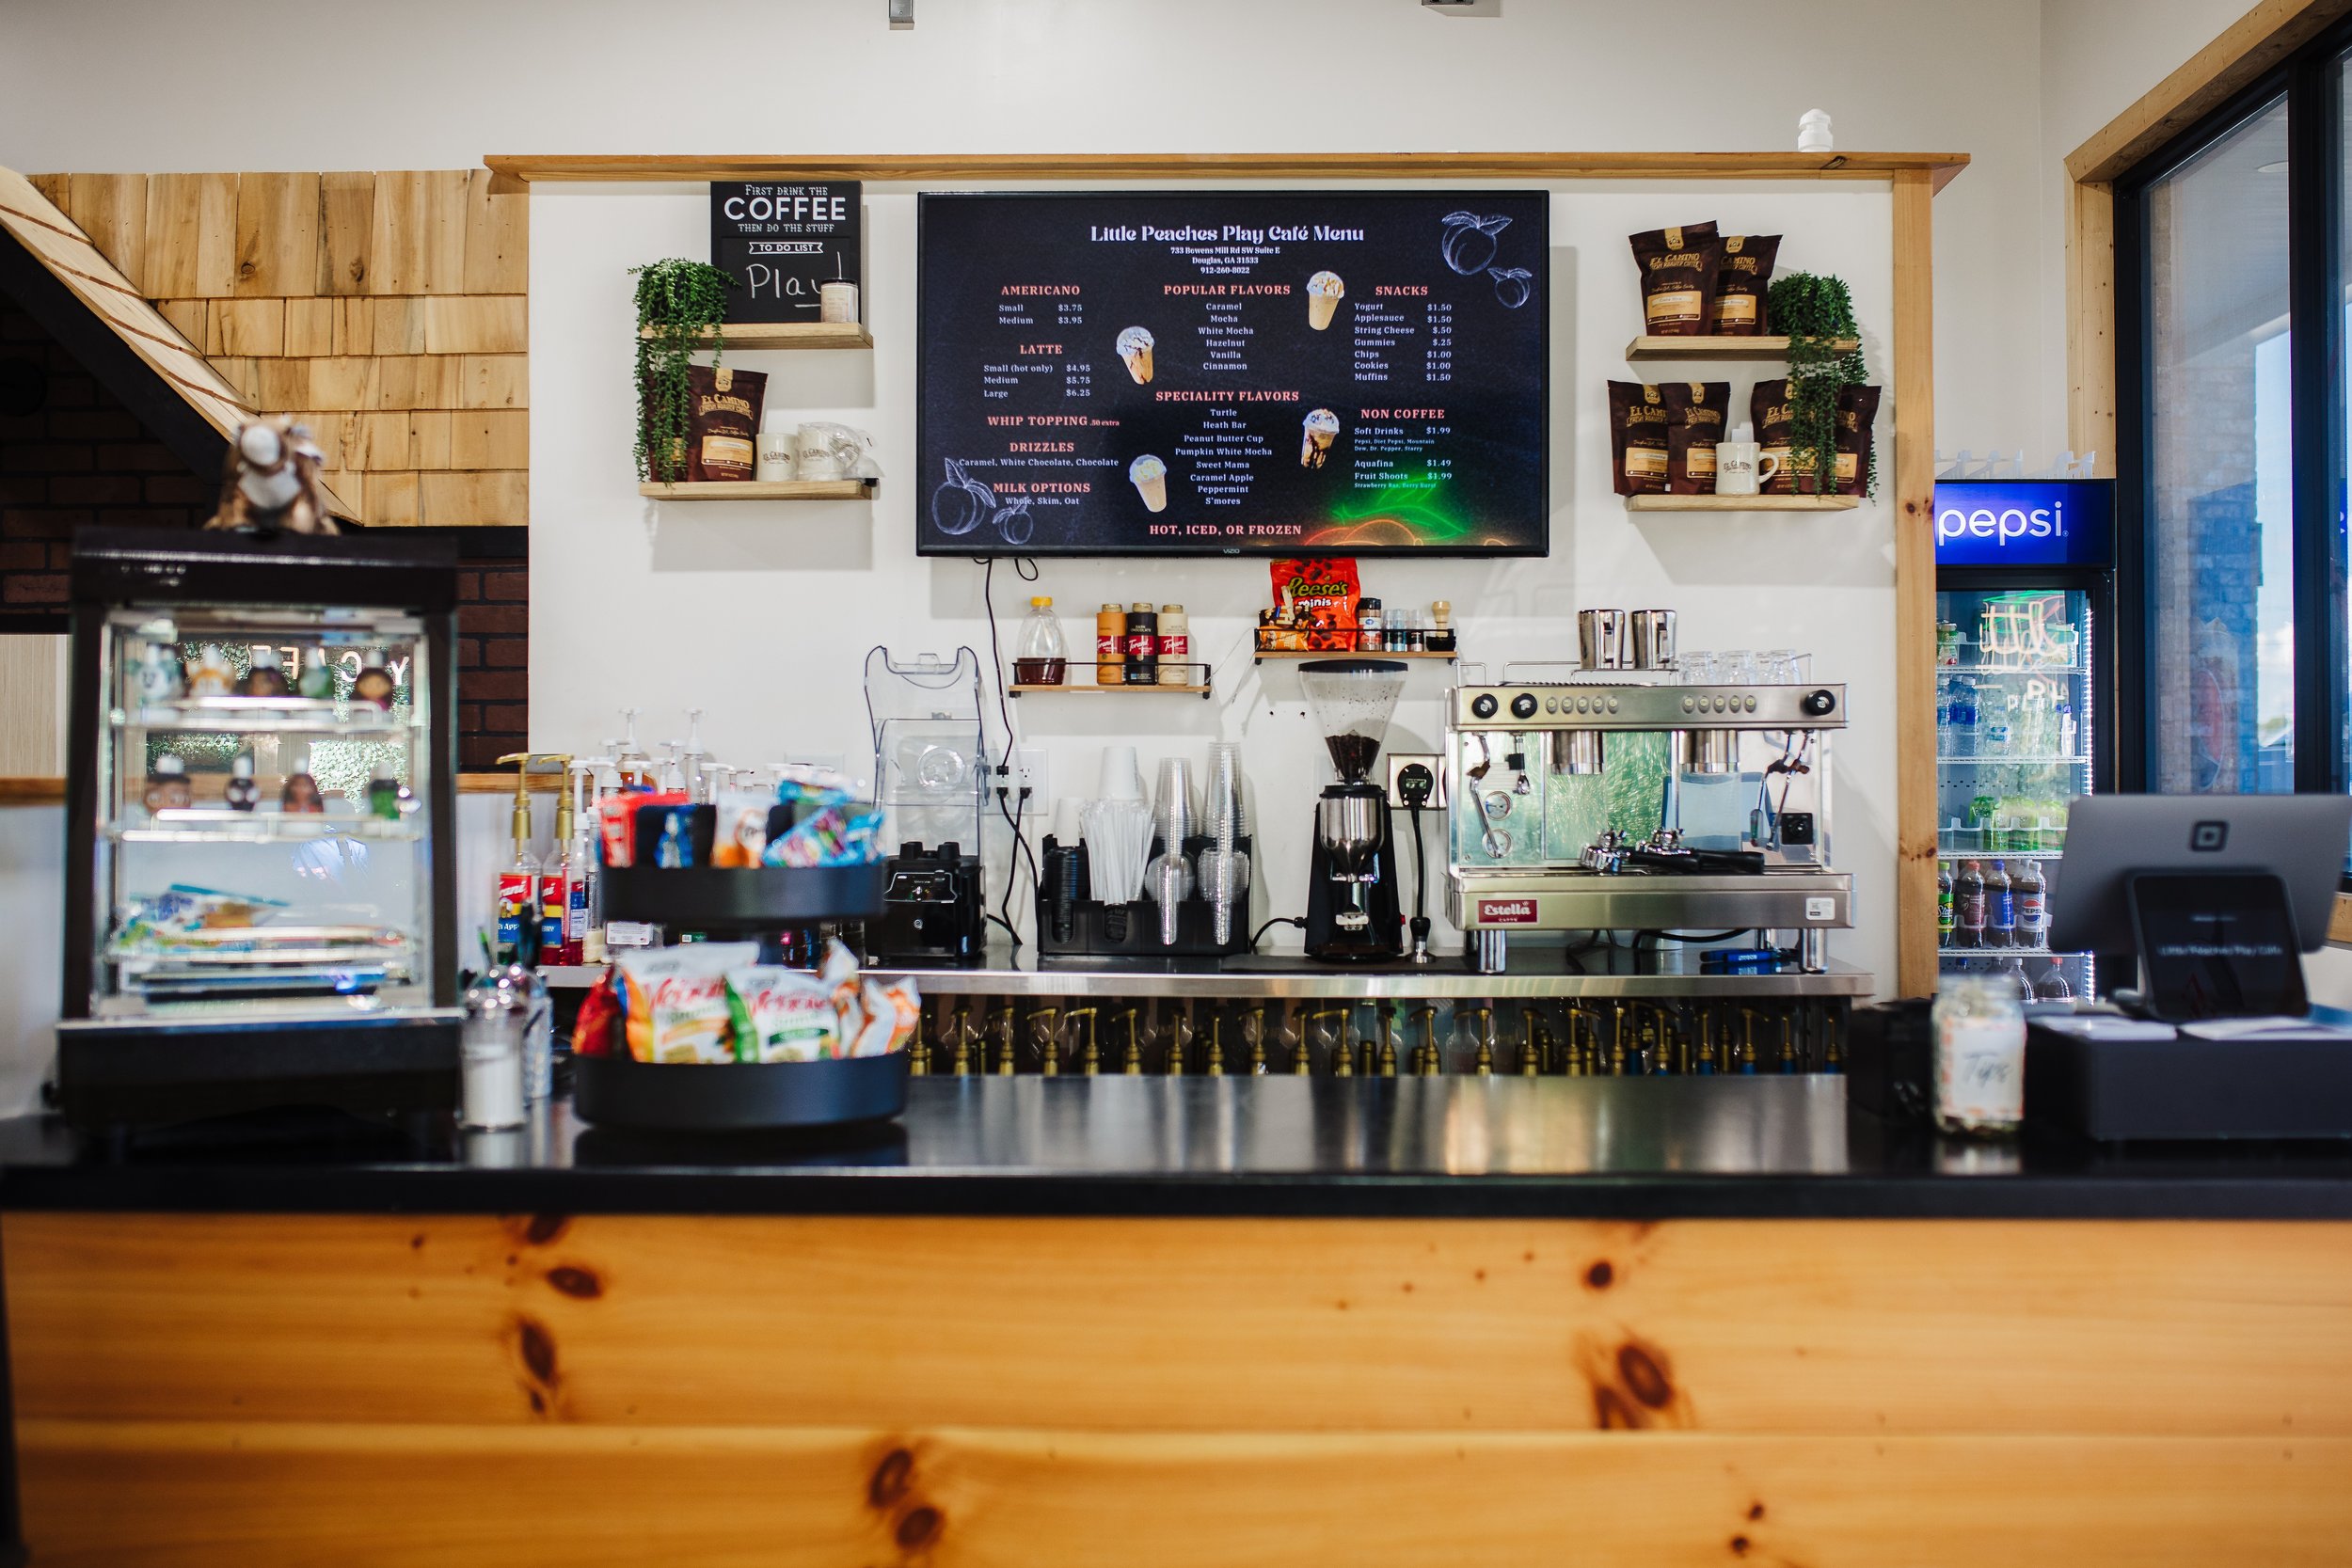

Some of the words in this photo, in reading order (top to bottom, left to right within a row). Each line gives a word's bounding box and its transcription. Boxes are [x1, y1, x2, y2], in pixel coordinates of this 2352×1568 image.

[724, 198, 846, 220] COFFEE
[784, 224, 802, 232] THE
[806, 224, 834, 232] STUFF
[1091, 226, 1136, 241] Little
[1142, 226, 1217, 241] Peaches
[1223, 226, 1263, 245] Play
[1269, 226, 1308, 241] Café
[1314, 226, 1363, 241] Menu
[1192, 257, 1223, 265] Douglas,
[1002, 286, 1079, 294] AMERICANO
[1165, 285, 1225, 294] POPULAR
[1231, 285, 1290, 294] FLAVORS
[1376, 286, 1427, 295] SNACKS
[1355, 303, 1383, 311] Yogurt
[1355, 314, 1404, 323] Applesauce
[1355, 326, 1381, 335] String
[1021, 345, 1062, 354] LATTE
[1355, 351, 1379, 359] Chips
[1011, 364, 1028, 372] (hot
[1031, 365, 1053, 373] only)
[1156, 391, 1233, 401] SPECIALITY
[1239, 391, 1298, 401] FLAVORS
[1361, 409, 1389, 419] NON
[1394, 409, 1444, 419] COFFEE
[988, 417, 1023, 425] WHIP
[1028, 417, 1087, 425] TOPPING
[1216, 435, 1245, 443] Butter
[1247, 435, 1263, 445] Cup
[1010, 443, 1073, 451] DRIZZLES
[1176, 448, 1214, 456] Pumpkin
[961, 459, 998, 467] Caramel,
[1355, 460, 1393, 468] Aquafina
[1230, 474, 1253, 483] Apple
[1379, 472, 1408, 481] Shoots
[1426, 472, 1452, 482] $1.99
[994, 483, 1026, 492] MILK
[1031, 483, 1089, 492] OPTIONS
[1199, 485, 1248, 494] Peppermint
[1006, 497, 1033, 506] Whole,
[1938, 501, 2062, 546] pepsi
[1150, 525, 1181, 535] HOT,
[1187, 526, 1221, 535] ICED,
[1227, 526, 1244, 534] OR
[1249, 526, 1301, 534] FROZEN
[1484, 903, 1532, 915] Estella
